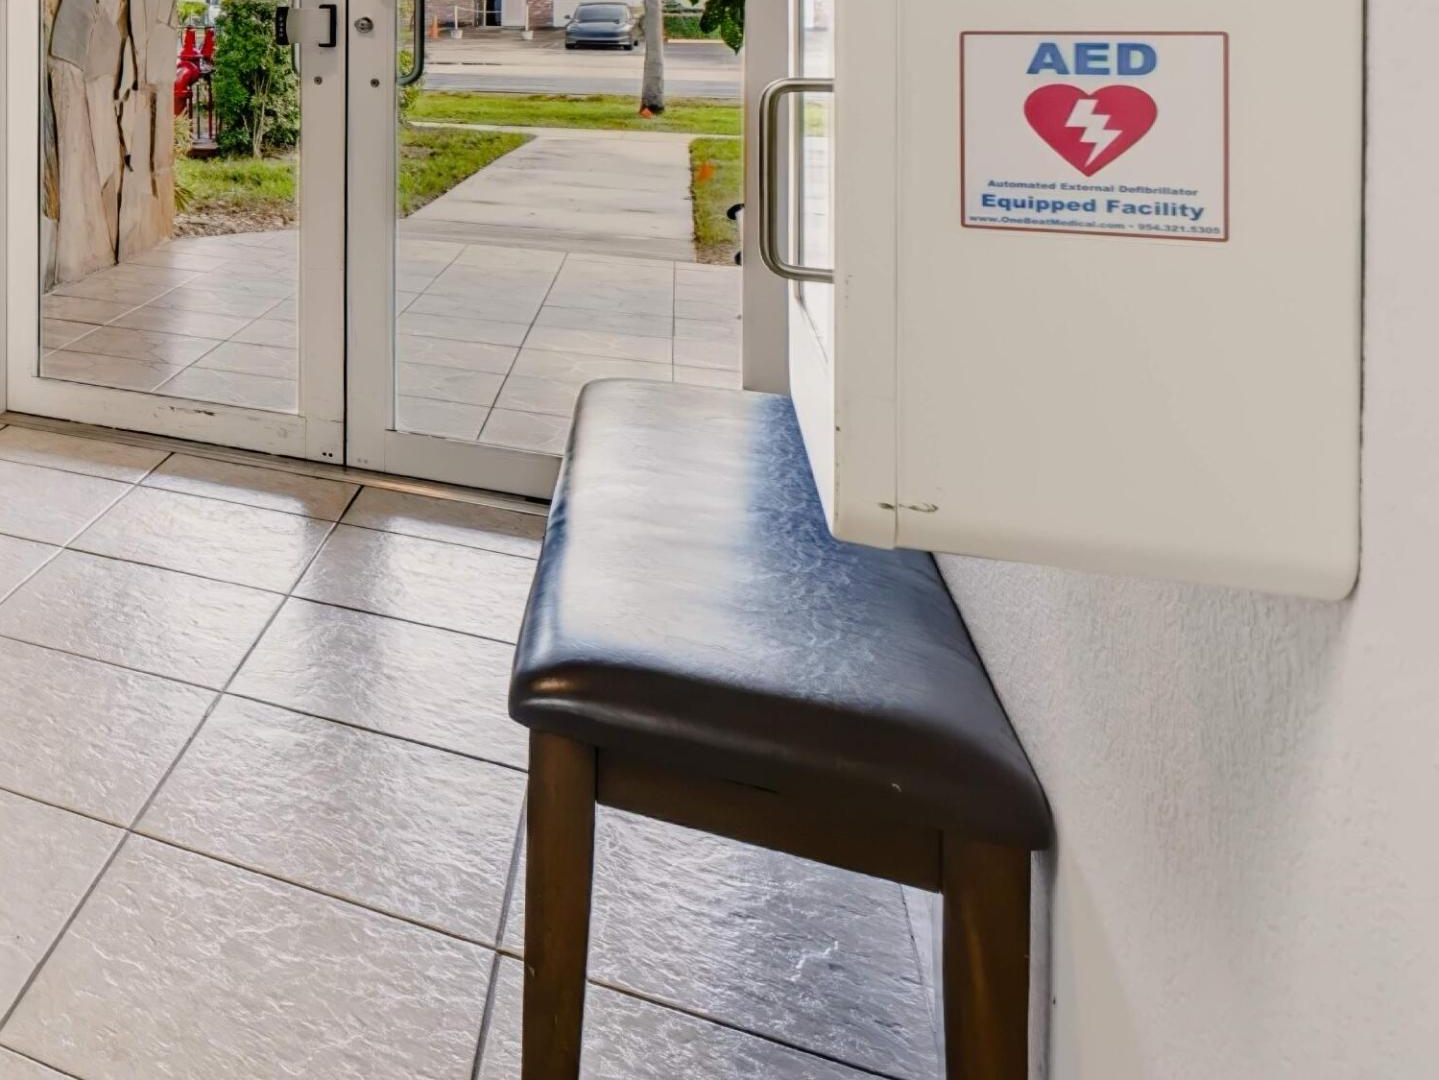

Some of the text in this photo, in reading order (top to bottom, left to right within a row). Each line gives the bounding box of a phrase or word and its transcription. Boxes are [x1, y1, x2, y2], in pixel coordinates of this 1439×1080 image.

[1026, 42, 1157, 76] AED
[987, 179, 1199, 197] Automated External Defibrillator
[982, 193, 1205, 222] Equipped Facility
